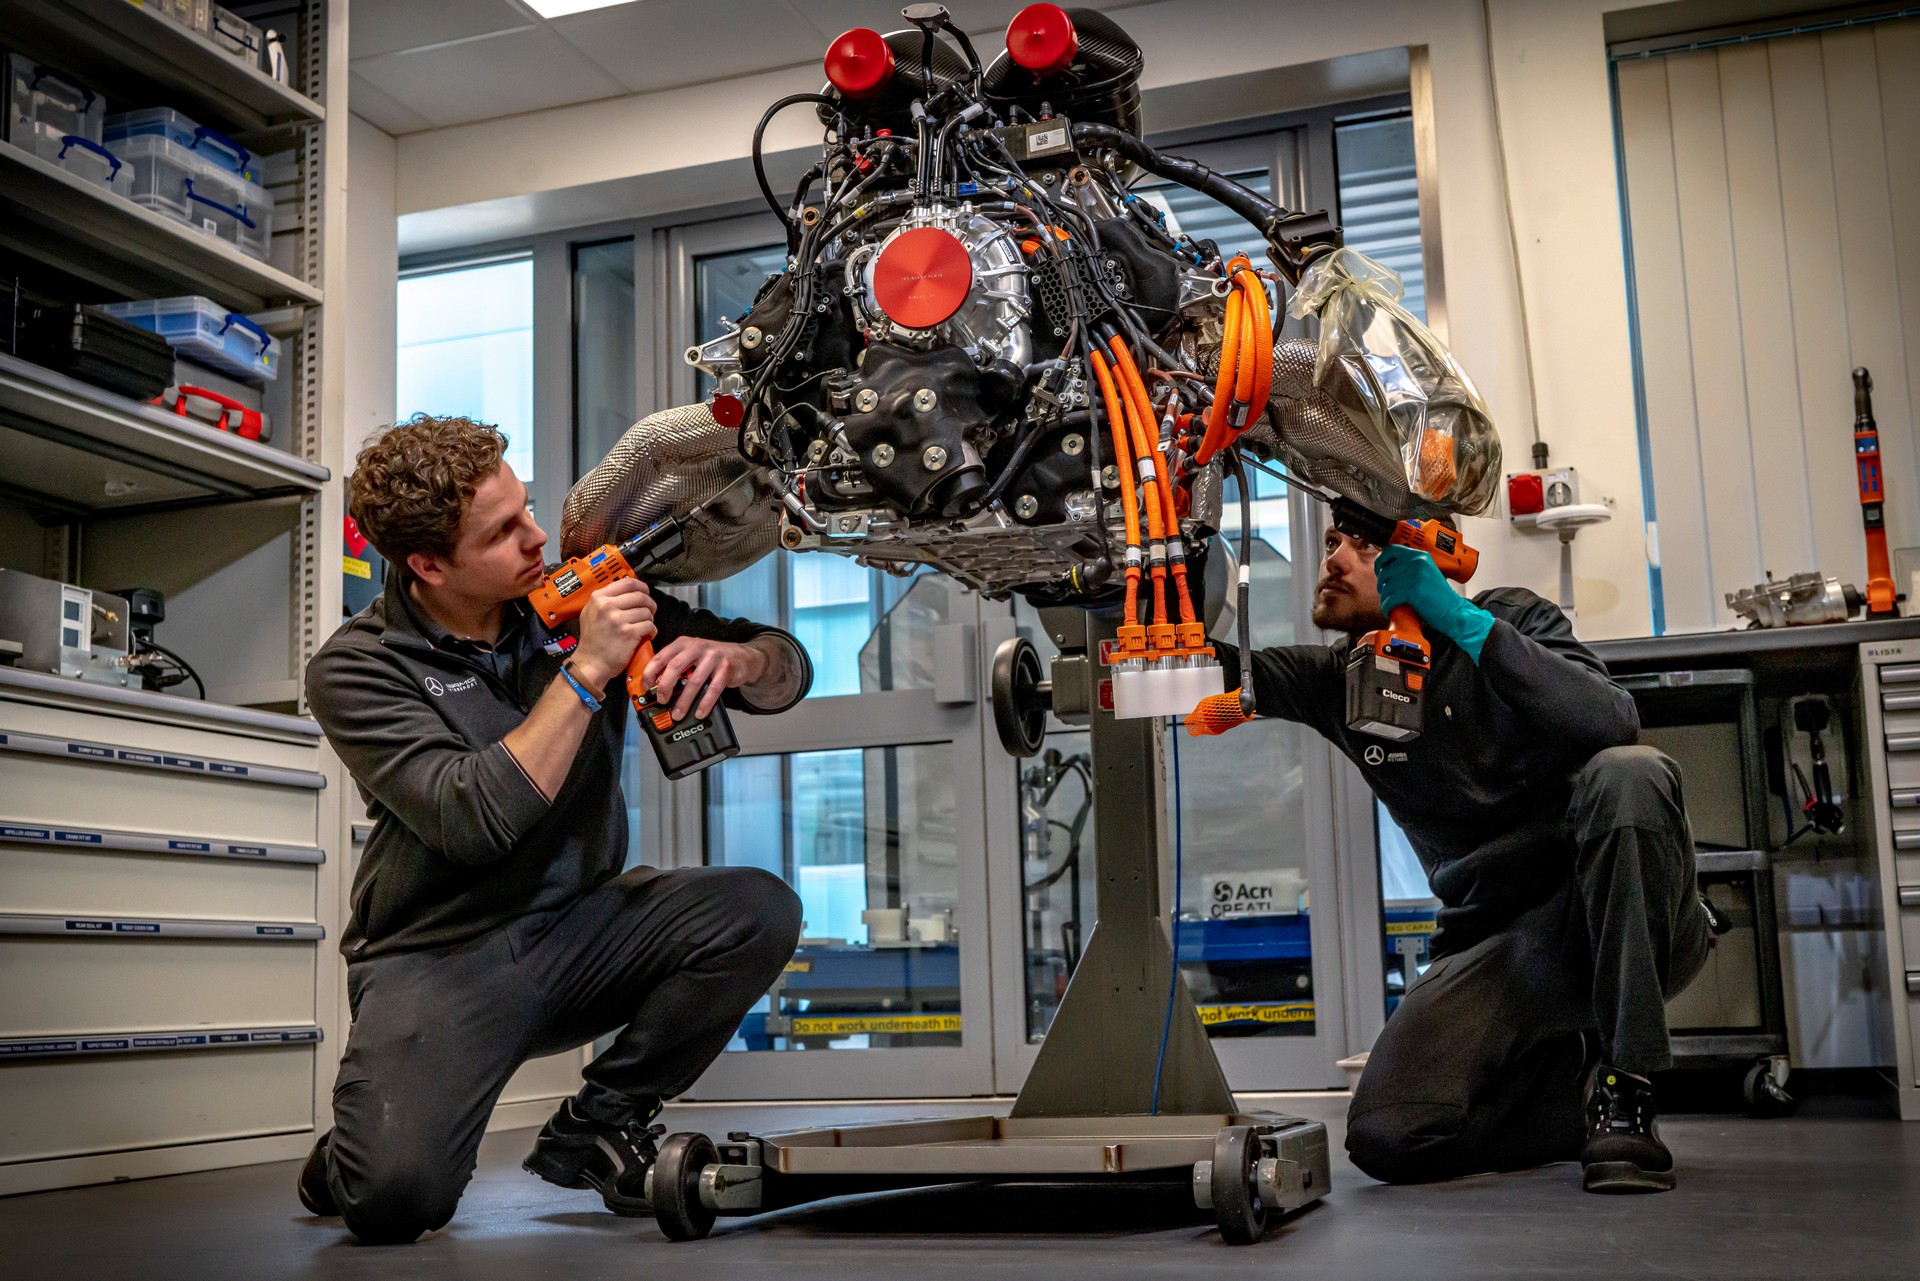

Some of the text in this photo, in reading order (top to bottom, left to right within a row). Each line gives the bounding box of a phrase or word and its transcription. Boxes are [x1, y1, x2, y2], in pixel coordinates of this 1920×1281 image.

[554, 571, 573, 584] Cleco
[543, 632, 568, 645] TOMMY
[551, 643, 578, 658] HILFIGER
[1875, 648, 1902, 656] LISTA
[1382, 688, 1410, 703] Cleco
[672, 722, 704, 742] Cleco
[24, 830, 45, 838] ASSEMBLY
[1200, 1006, 1315, 1021] not work undern
[793, 1018, 961, 1032] Do not work underneath thi
